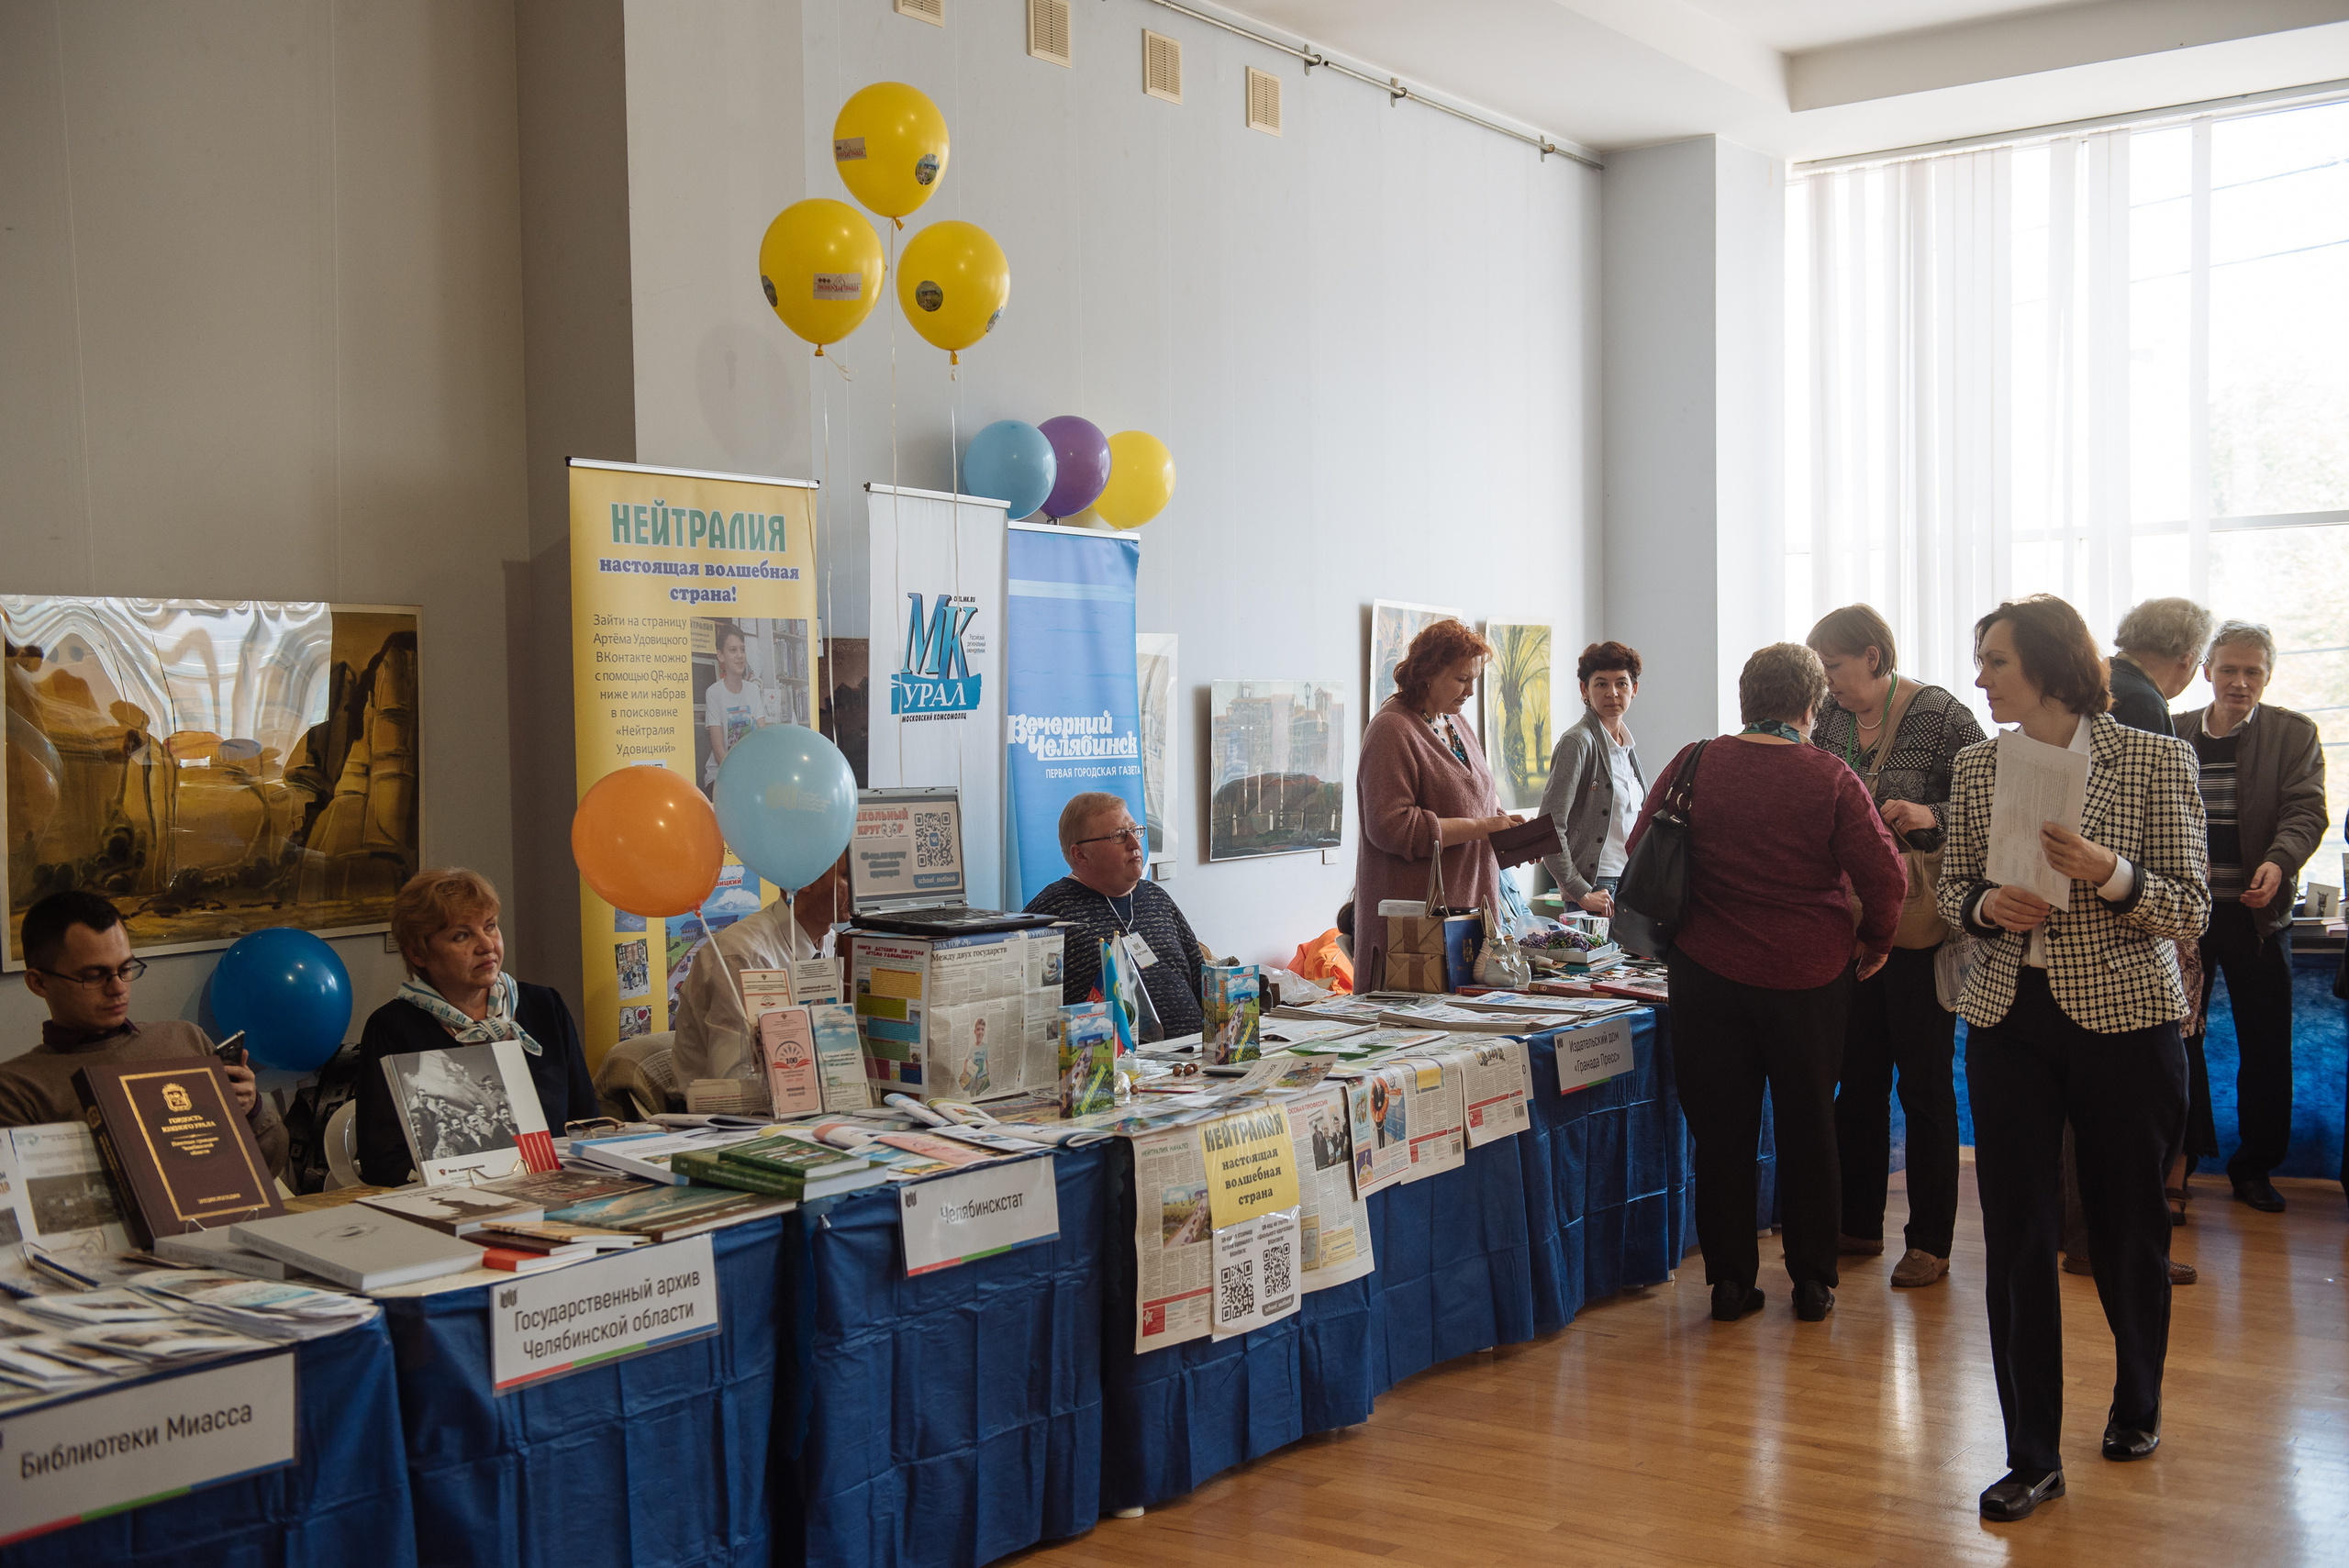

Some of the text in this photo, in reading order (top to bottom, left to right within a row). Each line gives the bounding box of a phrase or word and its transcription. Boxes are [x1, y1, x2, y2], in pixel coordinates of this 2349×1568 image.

[610, 499, 786, 552] НЕЙТРАЛИЯ
[599, 559, 800, 580] настоящая волшебная
[670, 586, 737, 604] страна!
[594, 614, 686, 629] Зайти на страницу
[593, 633, 631, 647] Артёма
[633, 633, 688, 647] Удовицкого
[901, 592, 978, 680] МК
[596, 651, 686, 662] ВКонтакте можно
[595, 670, 689, 684] с помощью QR-кода
[600, 688, 686, 702] ниже или набрав
[903, 683, 966, 708] УРАЛ
[611, 708, 678, 717] в поисковике
[902, 713, 932, 723] МОСКОВСКИЙ
[616, 724, 674, 739] «Нейтралия
[1007, 710, 1113, 744] Вечерний
[617, 742, 675, 757] Удовицкий»
[1028, 731, 1138, 761] Челябинск
[1046, 765, 1141, 778] ПЕРВАЯ ГОРОДСКАЯ ГАЗЕТА
[930, 947, 1007, 962] Между двух государств
[1568, 1031, 1620, 1053] Издательский дом
[1575, 1053, 1620, 1074] «Гранада Пресс»
[1305, 1099, 1328, 1110] ПРОФЕССИЯ
[1204, 1113, 1284, 1152] НЕЙТРАЛИЯ
[1170, 1142, 1188, 1151] НАЧАЛО
[1222, 1148, 1278, 1171] настоящая
[1225, 1166, 1281, 1189] волшебная
[1238, 1188, 1273, 1206] страна
[940, 1193, 1023, 1223] Челябинскстат
[515, 1271, 700, 1332] Государственный архив
[523, 1302, 695, 1360] Челябинской области
[20, 1405, 252, 1479] Библиотеки Миасса
